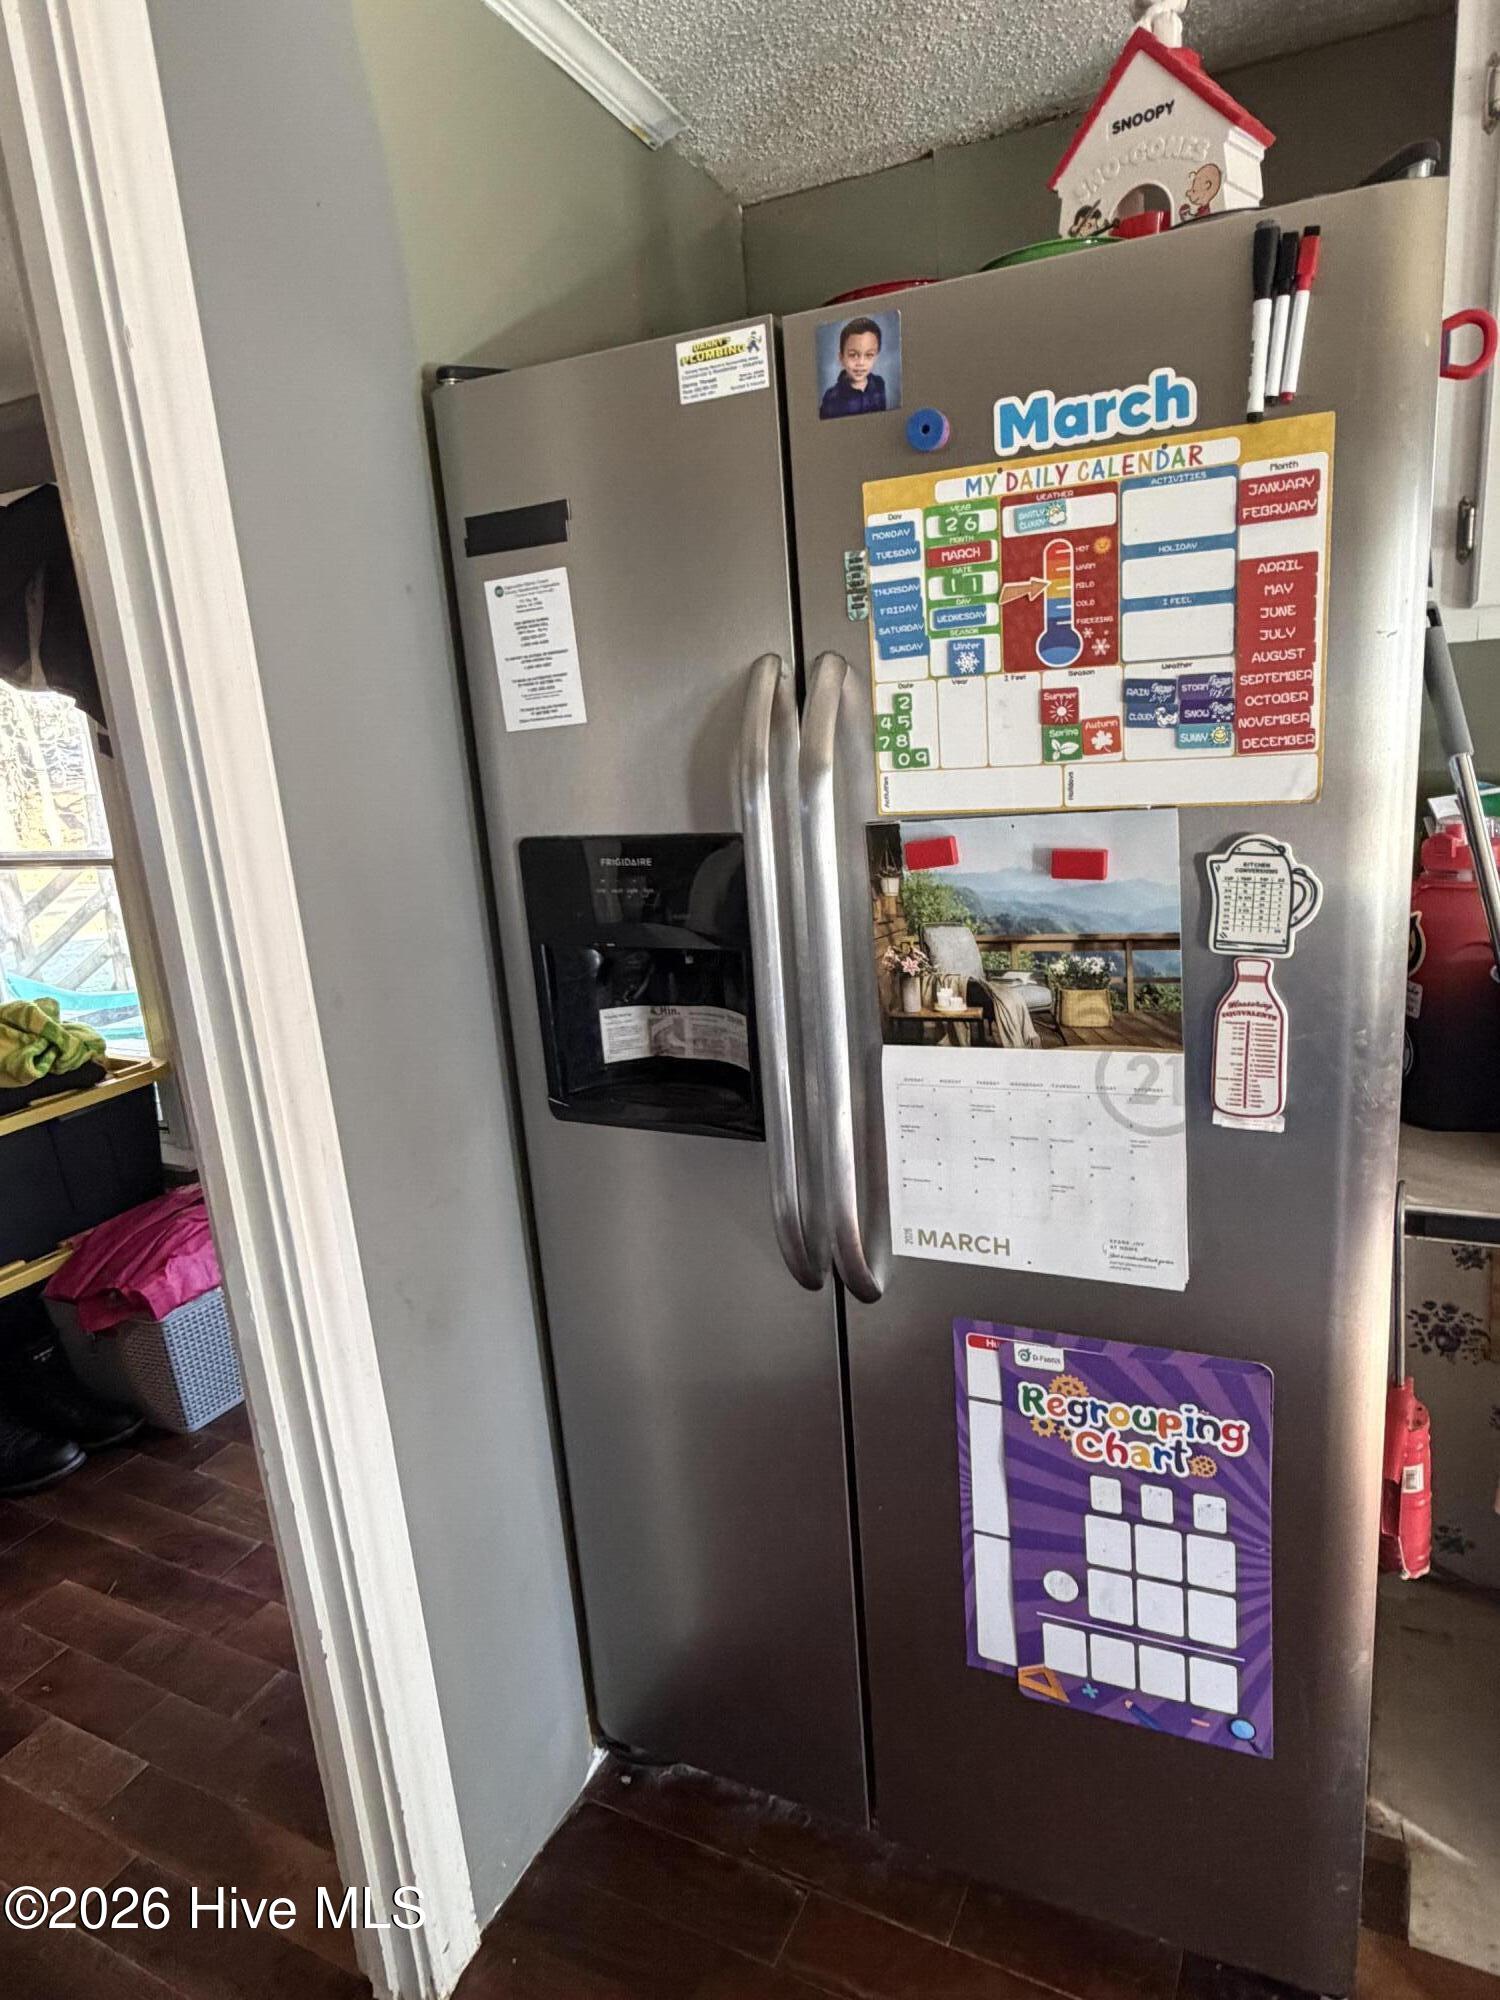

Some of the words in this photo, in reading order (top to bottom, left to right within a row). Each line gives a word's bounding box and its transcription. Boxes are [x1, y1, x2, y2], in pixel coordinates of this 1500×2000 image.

[1112, 100, 1175, 134] SNOOPY
[999, 373, 1190, 450] March
[965, 474, 998, 498] MY
[1005, 464, 1069, 492] DAILY
[1077, 445, 1204, 481] CALENDAR
[1269, 460, 1299, 471] Month
[1150, 471, 1207, 486] ACTIVITIES
[1248, 475, 1315, 496] JANUARY
[1035, 489, 1075, 502] WEATHER
[950, 503, 972, 512] YEAR
[1242, 498, 1318, 520] FEBRUARY
[872, 528, 911, 541] MONDAY
[950, 535, 975, 544] MONTH
[875, 547, 917, 560] TUESDAY
[1158, 542, 1198, 553] HOLIDAY
[941, 547, 981, 562] MARCH
[1075, 563, 1096, 571] WARM
[1257, 559, 1304, 575] APRIL
[873, 584, 920, 597] THURSDAY
[1075, 581, 1095, 589] MILD
[1263, 583, 1294, 596] MAY
[1169, 596, 1192, 605] FEEL
[879, 603, 918, 616] FRIDAY
[1259, 605, 1297, 618] JUNE
[937, 611, 987, 623] WEDNESDAY
[1075, 615, 1114, 624] FREEZING
[878, 623, 925, 636] SATURDAY
[950, 628, 979, 636] SEASON
[1259, 627, 1296, 641] JULY
[889, 642, 924, 654] SUNDAY
[953, 641, 981, 651] Winter
[1251, 647, 1306, 664] AUGUST
[1161, 662, 1194, 670] Weather
[1068, 669, 1096, 677] Season
[1240, 668, 1313, 686] SEPTEMBER
[897, 682, 914, 690] Date
[1126, 688, 1150, 697] RAIN
[1181, 683, 1210, 692] STORM
[899, 696, 911, 710] 2
[1043, 692, 1078, 701] Summer
[1244, 691, 1309, 707] OCTOBER
[1128, 712, 1155, 721] CLOUDY
[1184, 709, 1210, 718] SNOW
[880, 716, 893, 731] 4
[897, 715, 910, 729] 5
[1085, 718, 1119, 730] Autumn
[1238, 712, 1310, 729] NOVEMBER
[1048, 728, 1080, 738] Spring
[1180, 732, 1208, 743] SUNNY
[879, 735, 890, 749] 7
[895, 734, 908, 748] 8
[1242, 733, 1316, 750] DECEMBER
[915, 751, 927, 765] 9
[600, 857, 653, 867] FRIGIDAIRE
[917, 1228, 1011, 1257] MARCH
[1021, 1383, 1247, 1453] Regrouping
[1074, 1430, 1190, 1474] Chart
